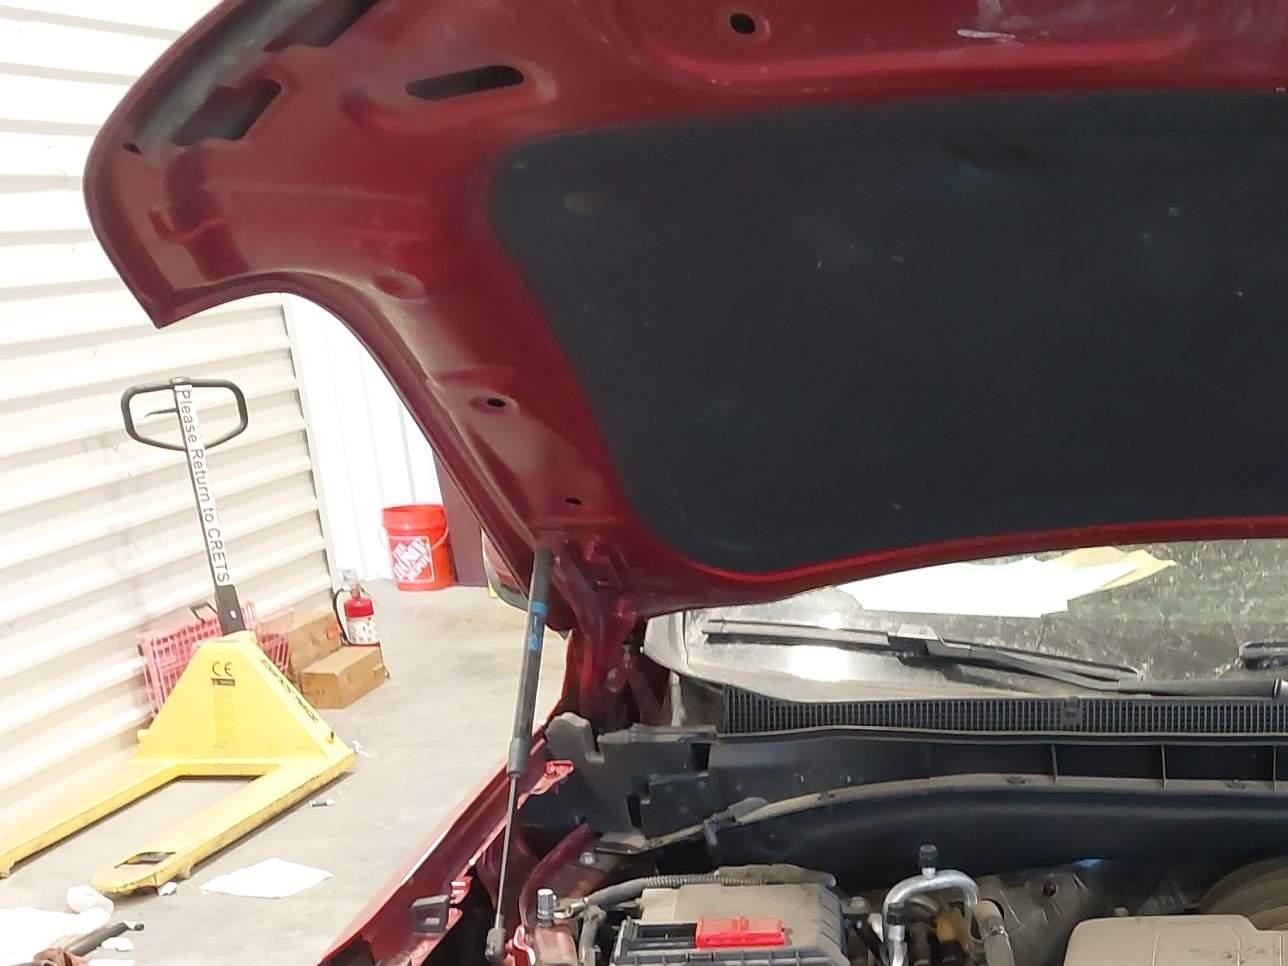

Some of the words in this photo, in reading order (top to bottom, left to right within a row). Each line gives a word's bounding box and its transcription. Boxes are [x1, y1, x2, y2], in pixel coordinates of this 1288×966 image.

[176, 389, 197, 443] Please
[190, 448, 210, 502] Return
[203, 507, 215, 523] to
[207, 527, 230, 583] CRETS
